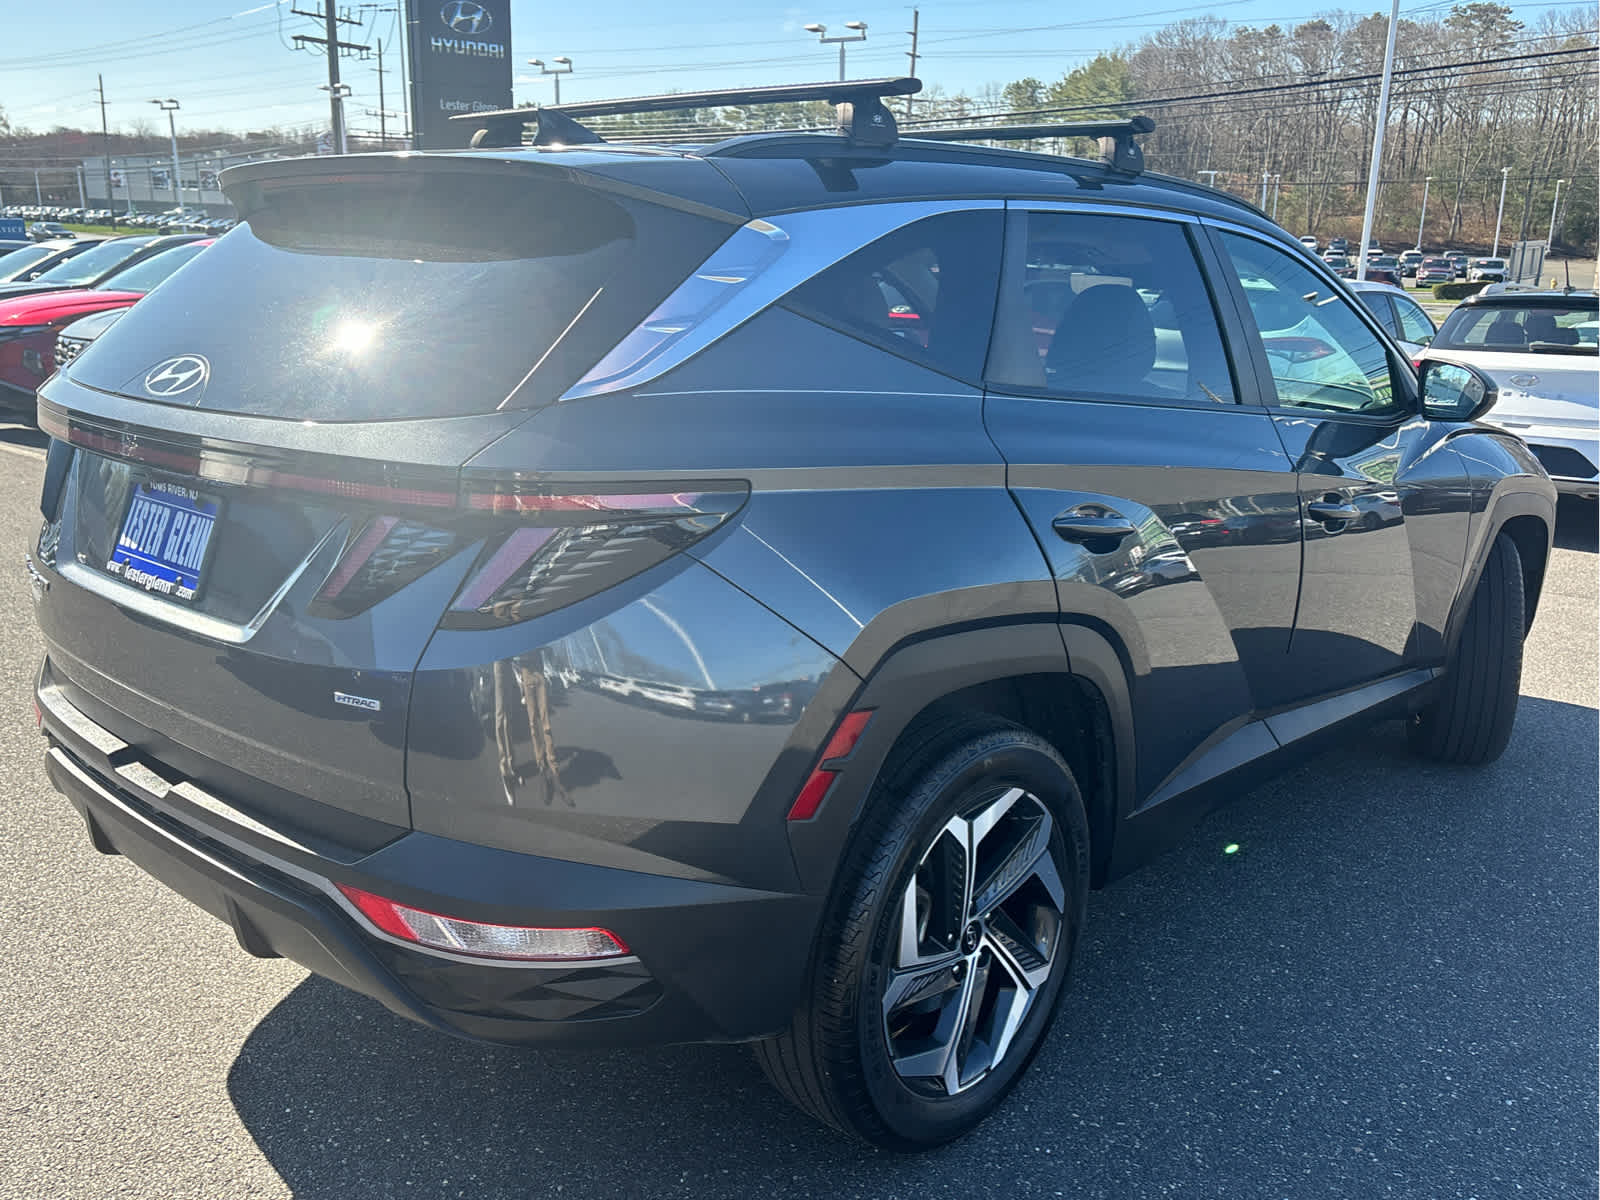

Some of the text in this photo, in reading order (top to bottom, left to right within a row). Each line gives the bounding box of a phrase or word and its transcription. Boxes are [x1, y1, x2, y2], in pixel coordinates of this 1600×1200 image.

[431, 36, 505, 58] HYUNDAI
[440, 98, 469, 111] Lester
[189, 488, 199, 501] NJ
[119, 498, 215, 572] LESTER GLENN
[124, 564, 172, 594] lesterglenn
[335, 694, 378, 709] HTRAC
